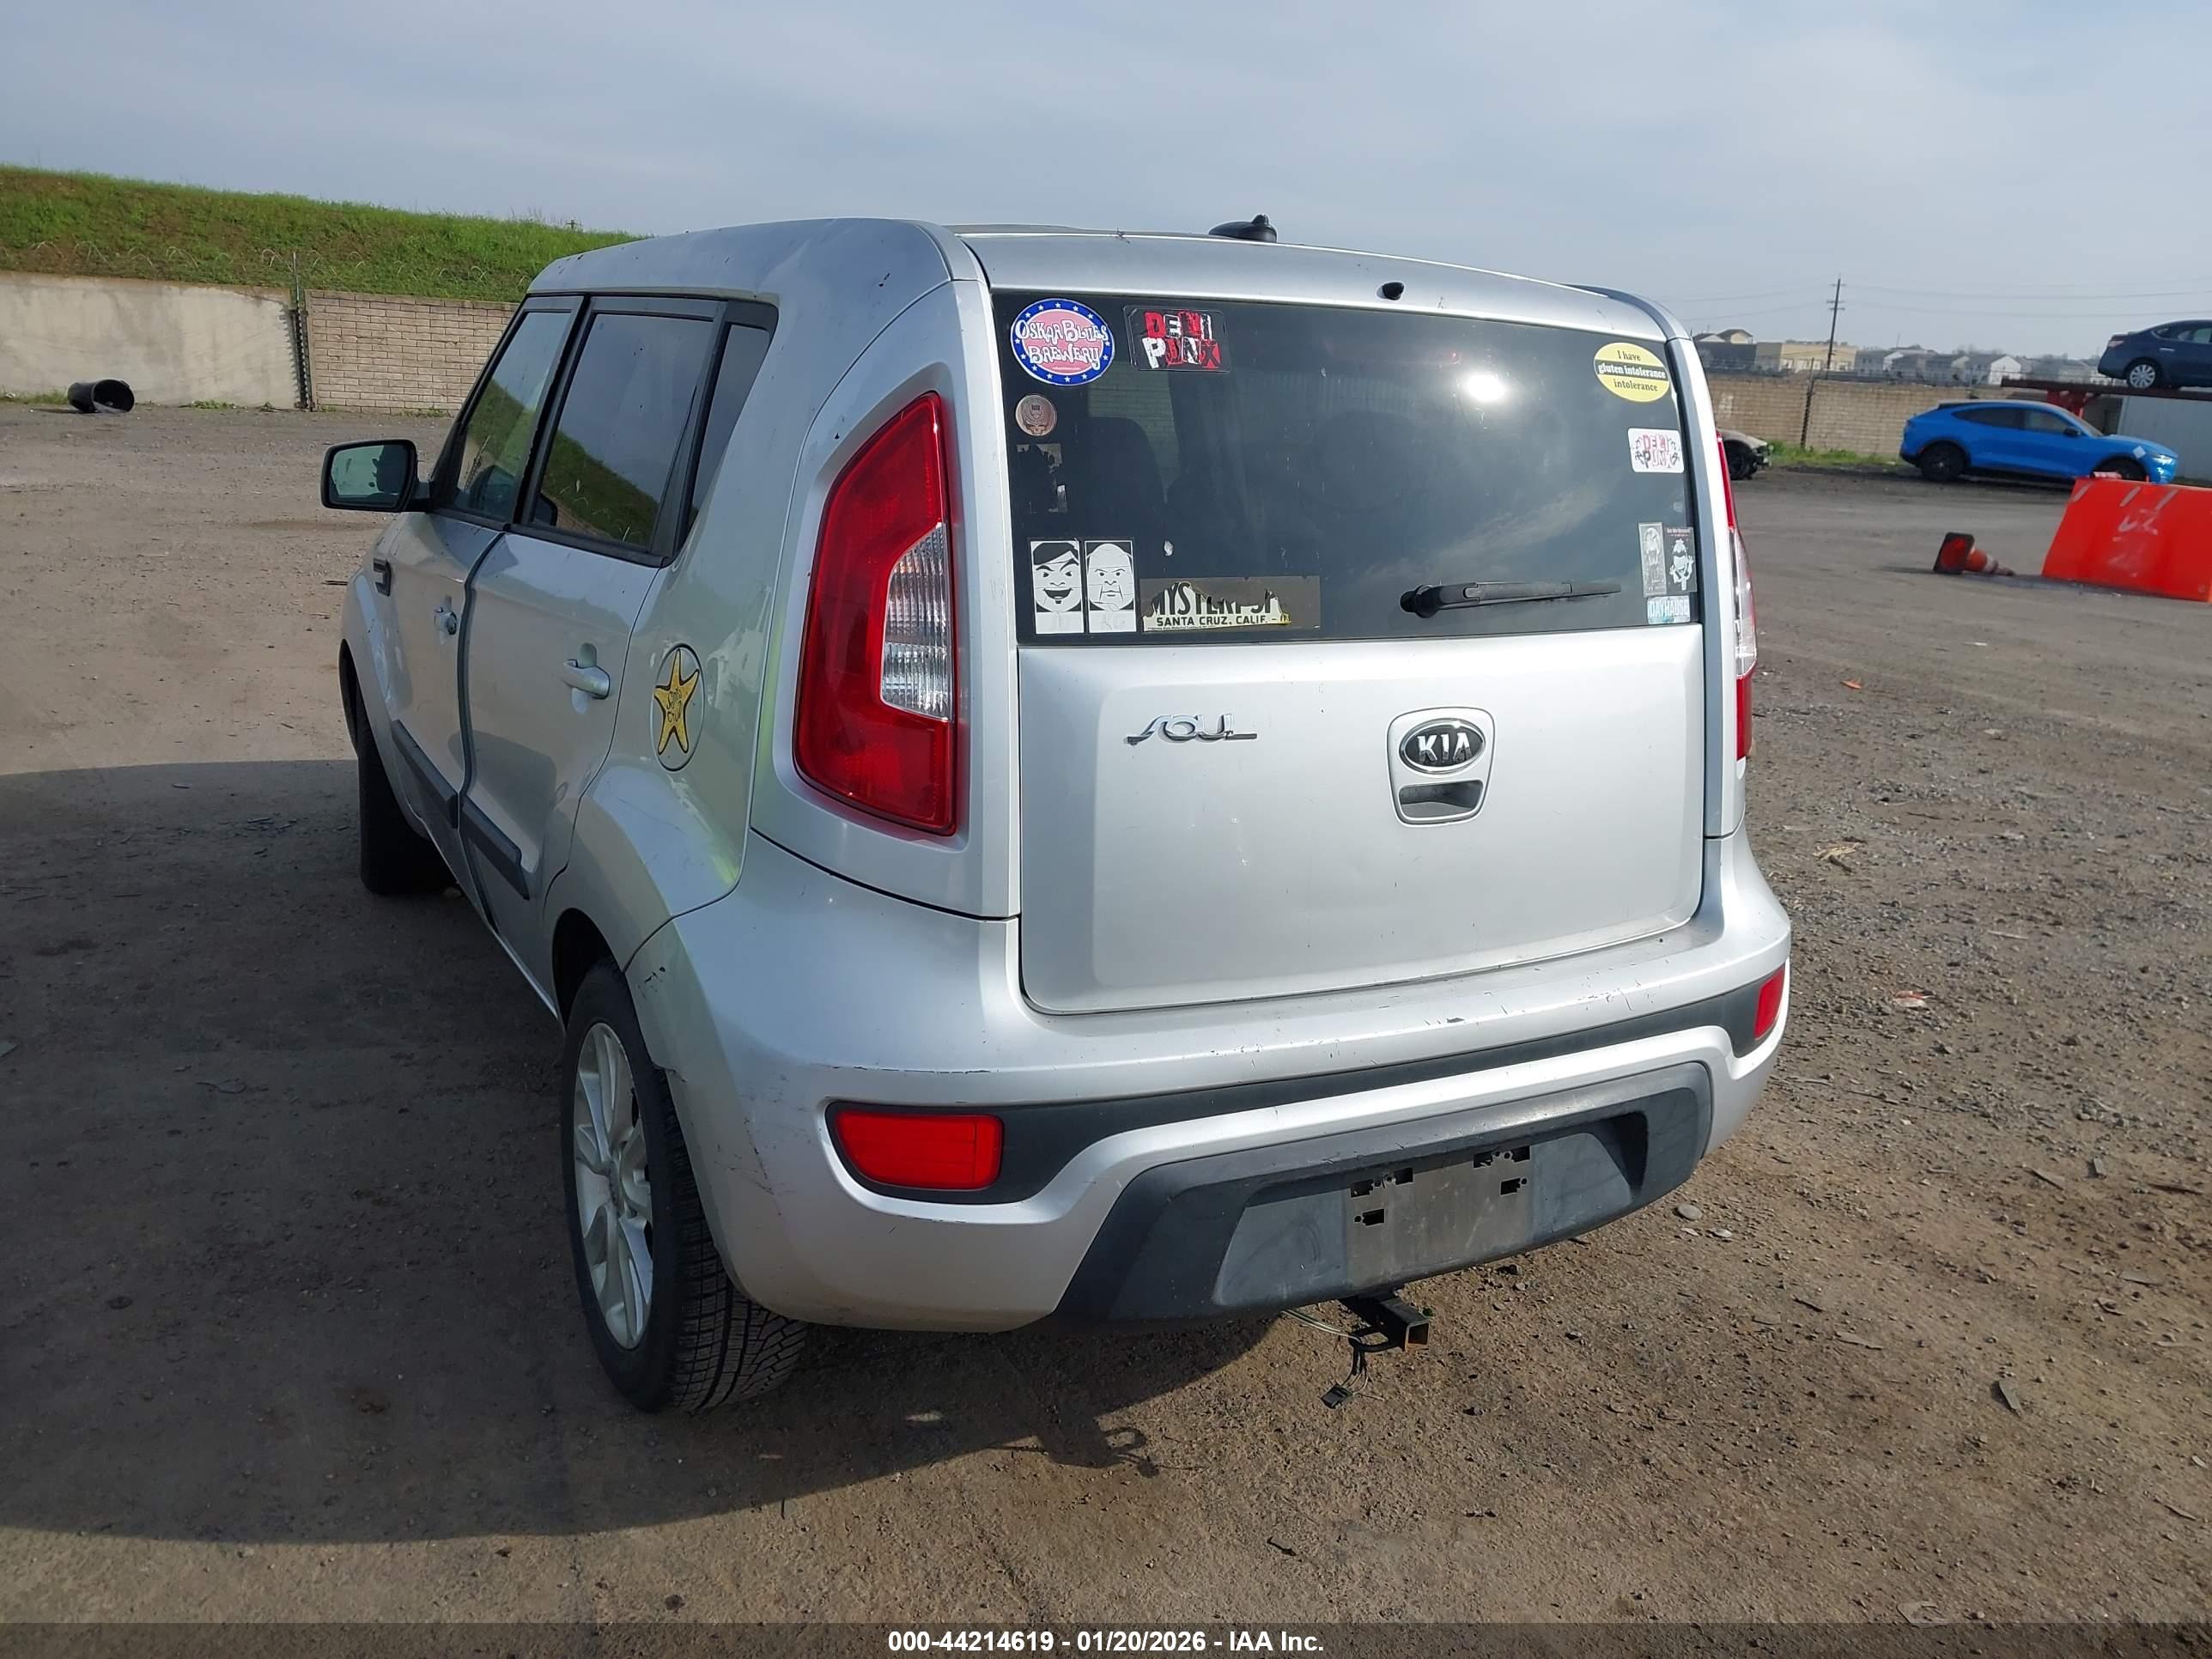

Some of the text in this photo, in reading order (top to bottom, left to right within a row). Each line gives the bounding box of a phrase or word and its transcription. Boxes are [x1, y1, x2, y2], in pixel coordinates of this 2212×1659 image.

[1015, 319, 1109, 345] OSKAR BLUES
[1028, 343, 1101, 370] BREWERY
[1617, 350, 1641, 362] I have
[1598, 362, 1666, 378] gluten intolerance
[1613, 379, 1658, 392] intolerance
[1157, 617, 1194, 627] SANTA
[1126, 714, 1258, 744] SOUL
[1416, 732, 1473, 765] KIA
